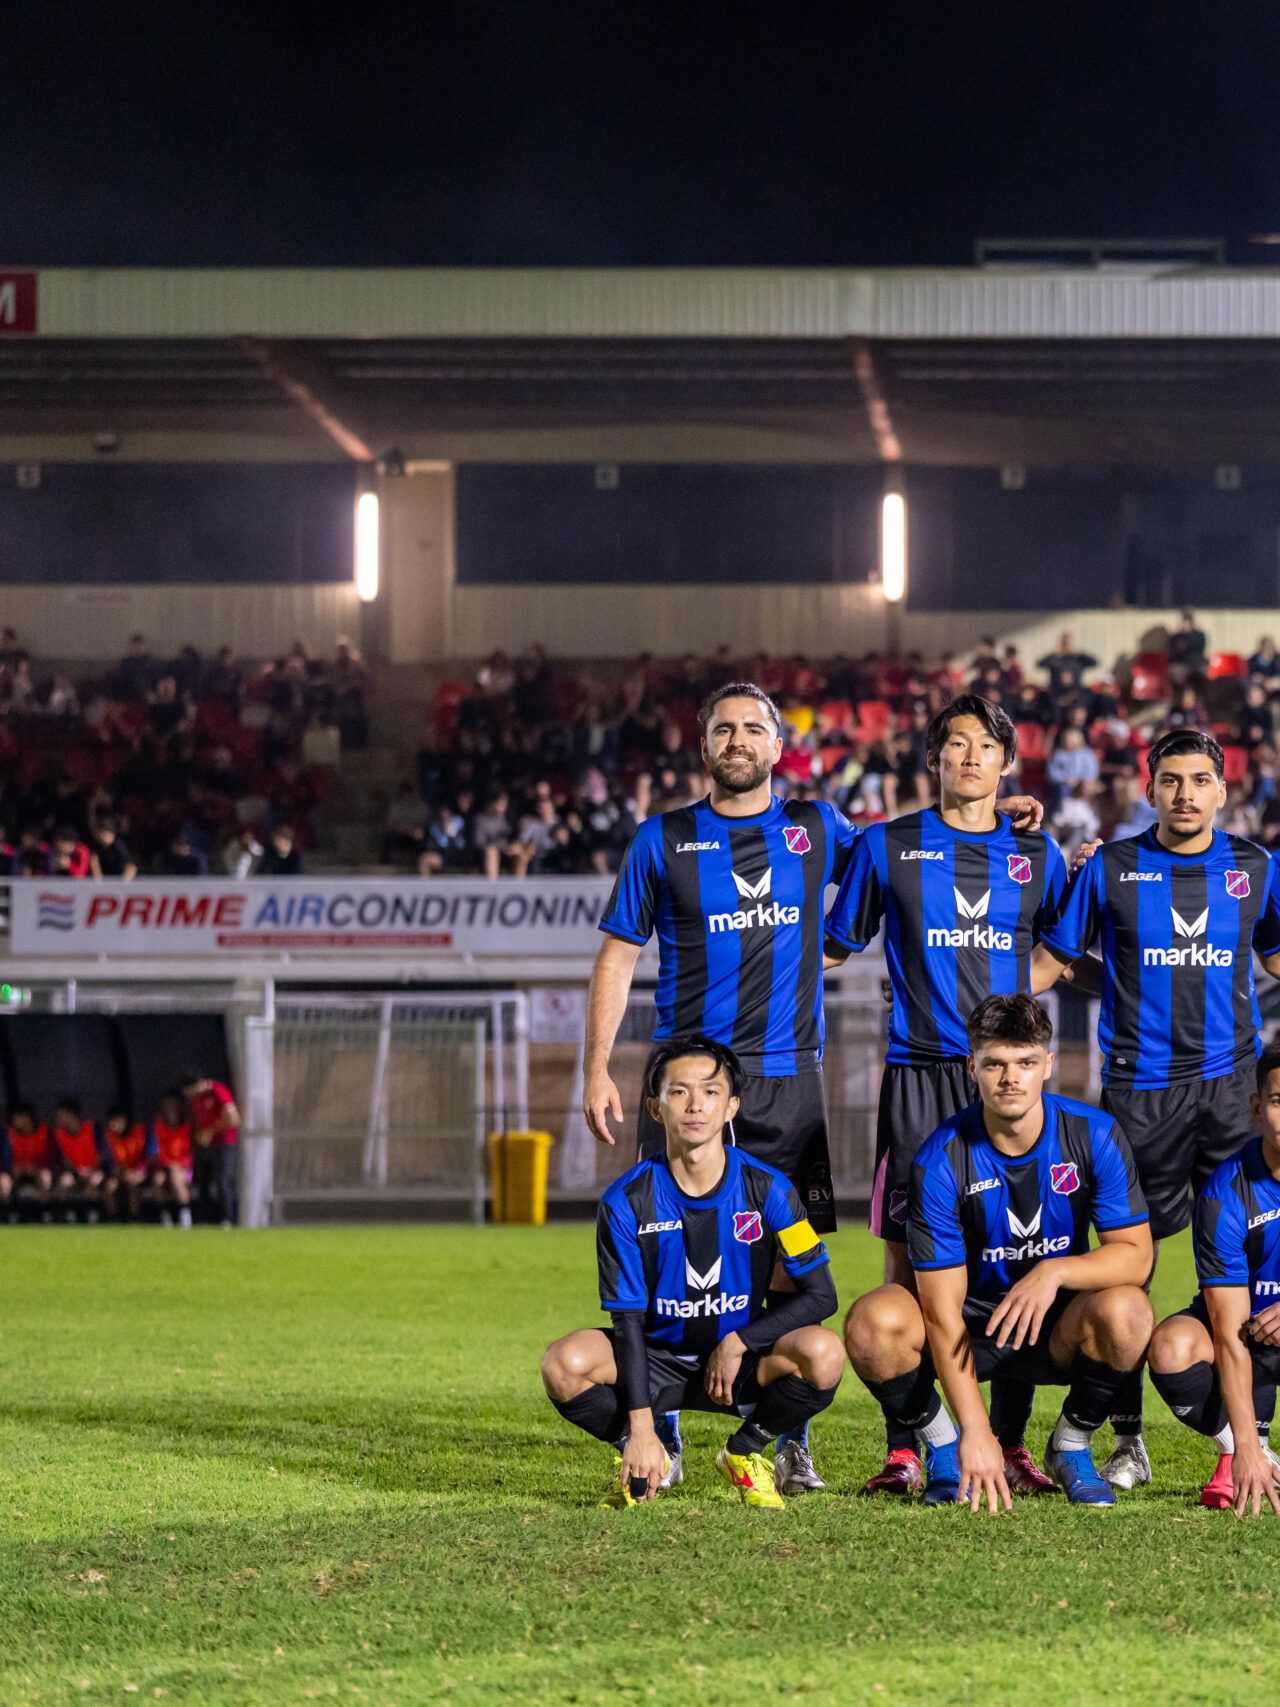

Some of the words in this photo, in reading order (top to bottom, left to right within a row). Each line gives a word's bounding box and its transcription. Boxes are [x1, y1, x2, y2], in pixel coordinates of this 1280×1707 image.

[676, 841, 720, 853] LEGEA
[900, 850, 945, 861] LEGEA
[1119, 872, 1163, 882] LEGEA
[86, 894, 247, 928] PRIME
[255, 893, 601, 928] AIRCONDITIONIN
[708, 902, 800, 933] markka
[927, 924, 1013, 951] markka
[1143, 943, 1233, 967] markka
[964, 1178, 1002, 1196] LEGEA
[638, 1219, 683, 1235] LEGEA
[981, 1235, 1071, 1263] markka
[656, 1292, 749, 1319] markka
